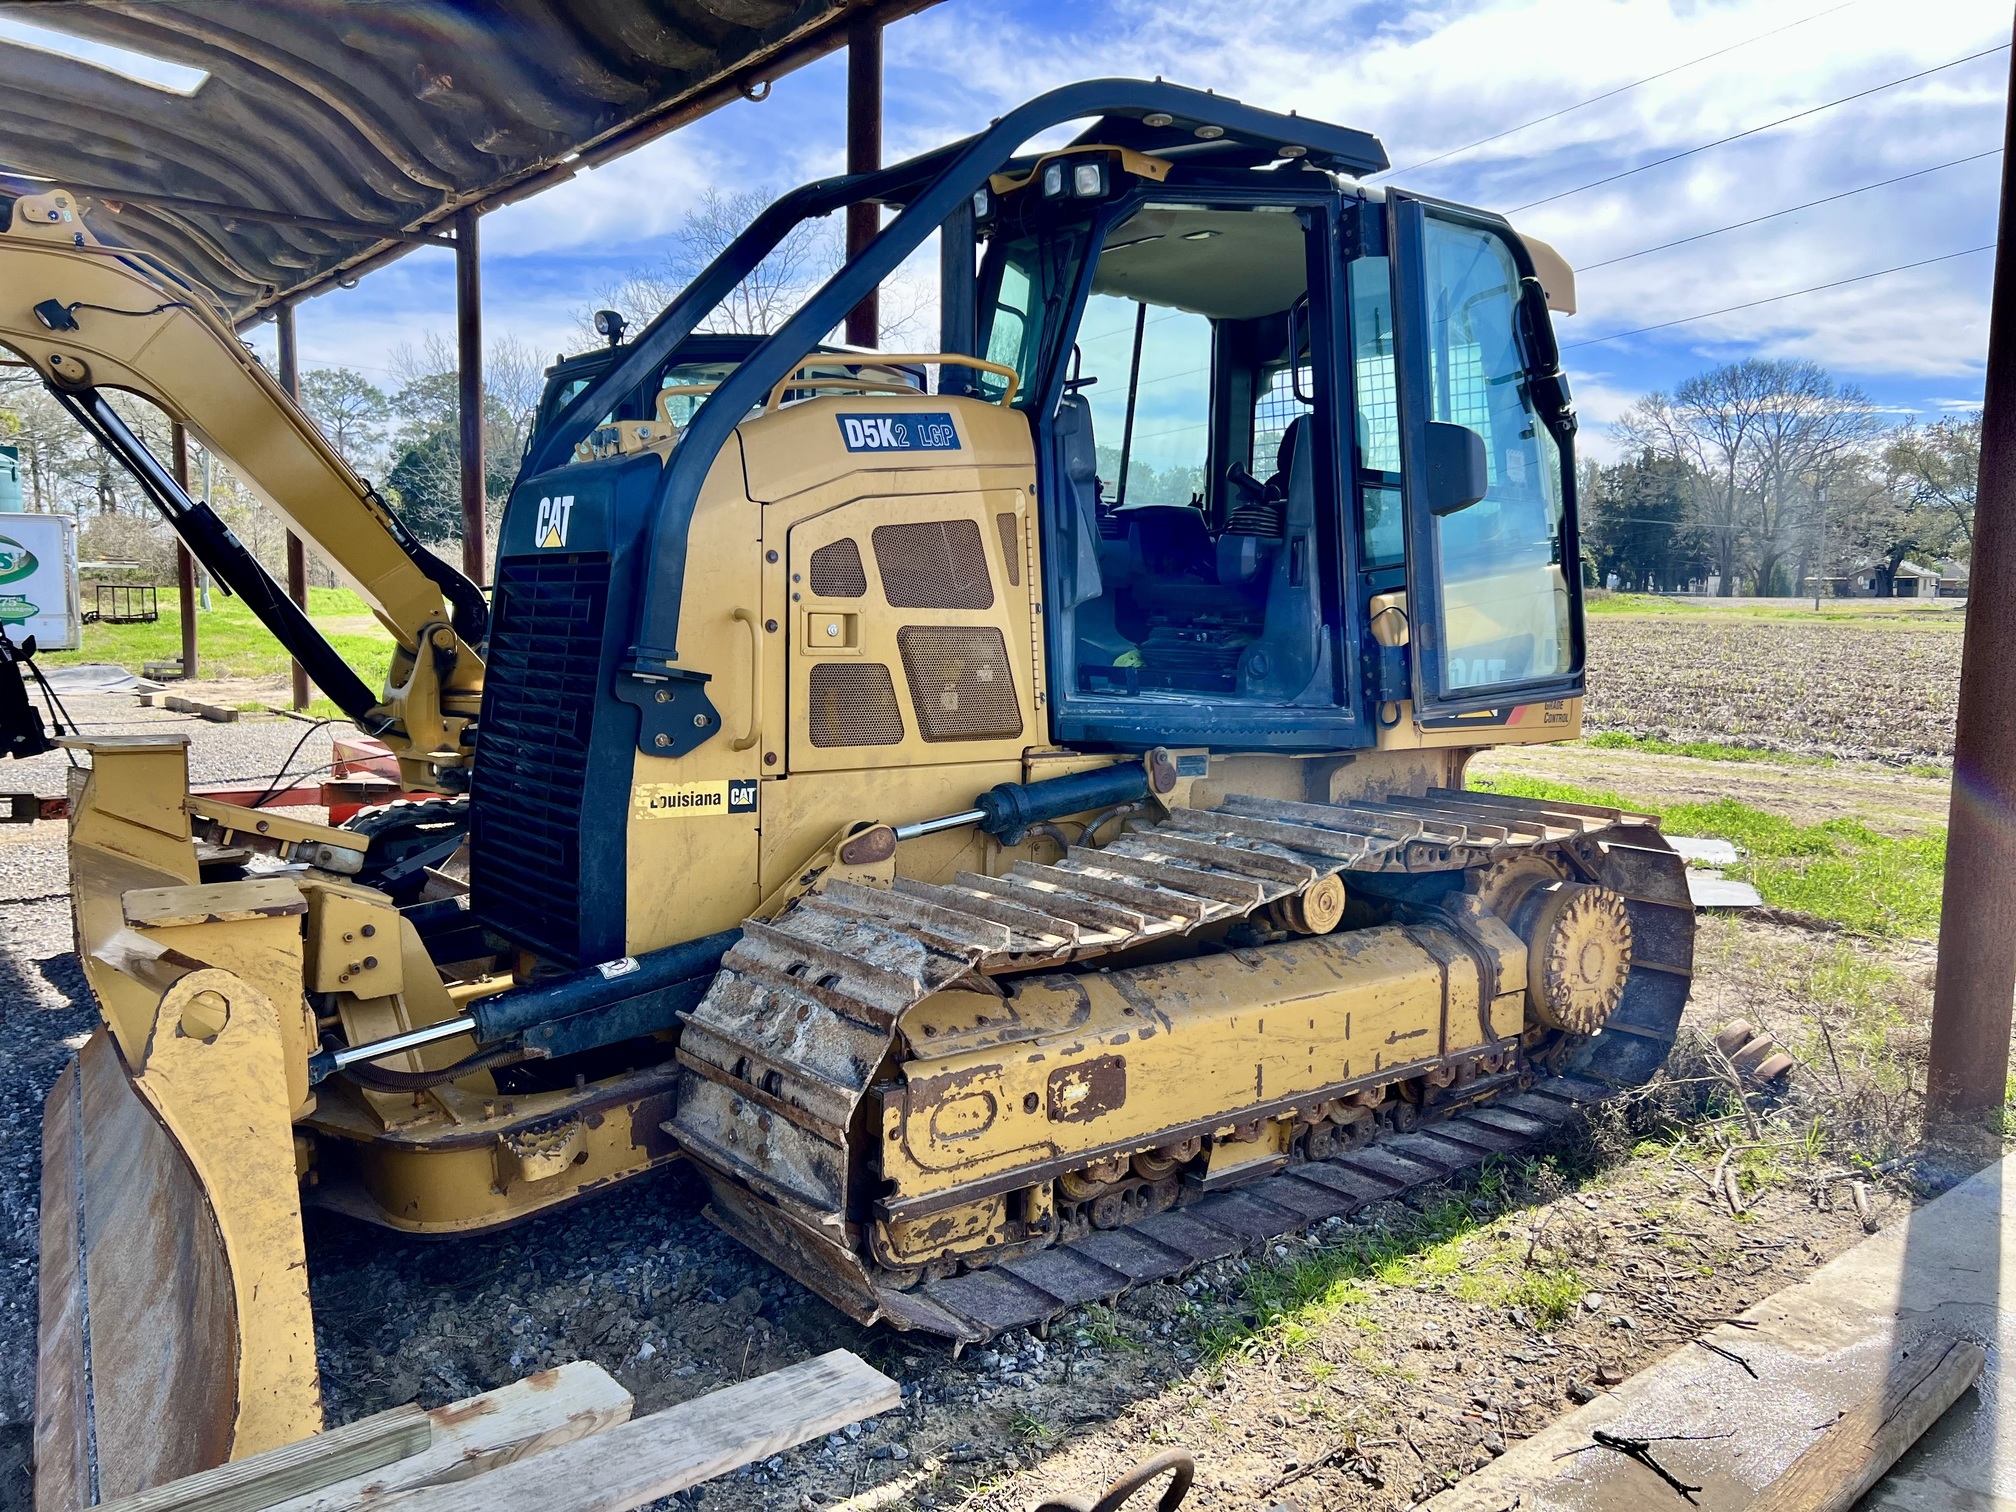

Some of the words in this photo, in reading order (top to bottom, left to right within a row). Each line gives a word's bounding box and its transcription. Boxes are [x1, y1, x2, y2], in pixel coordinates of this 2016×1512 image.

[918, 424, 955, 447] LGP
[535, 495, 575, 549] CAT
[1543, 712, 1569, 724] CONTROL
[730, 787, 758, 806] CAT
